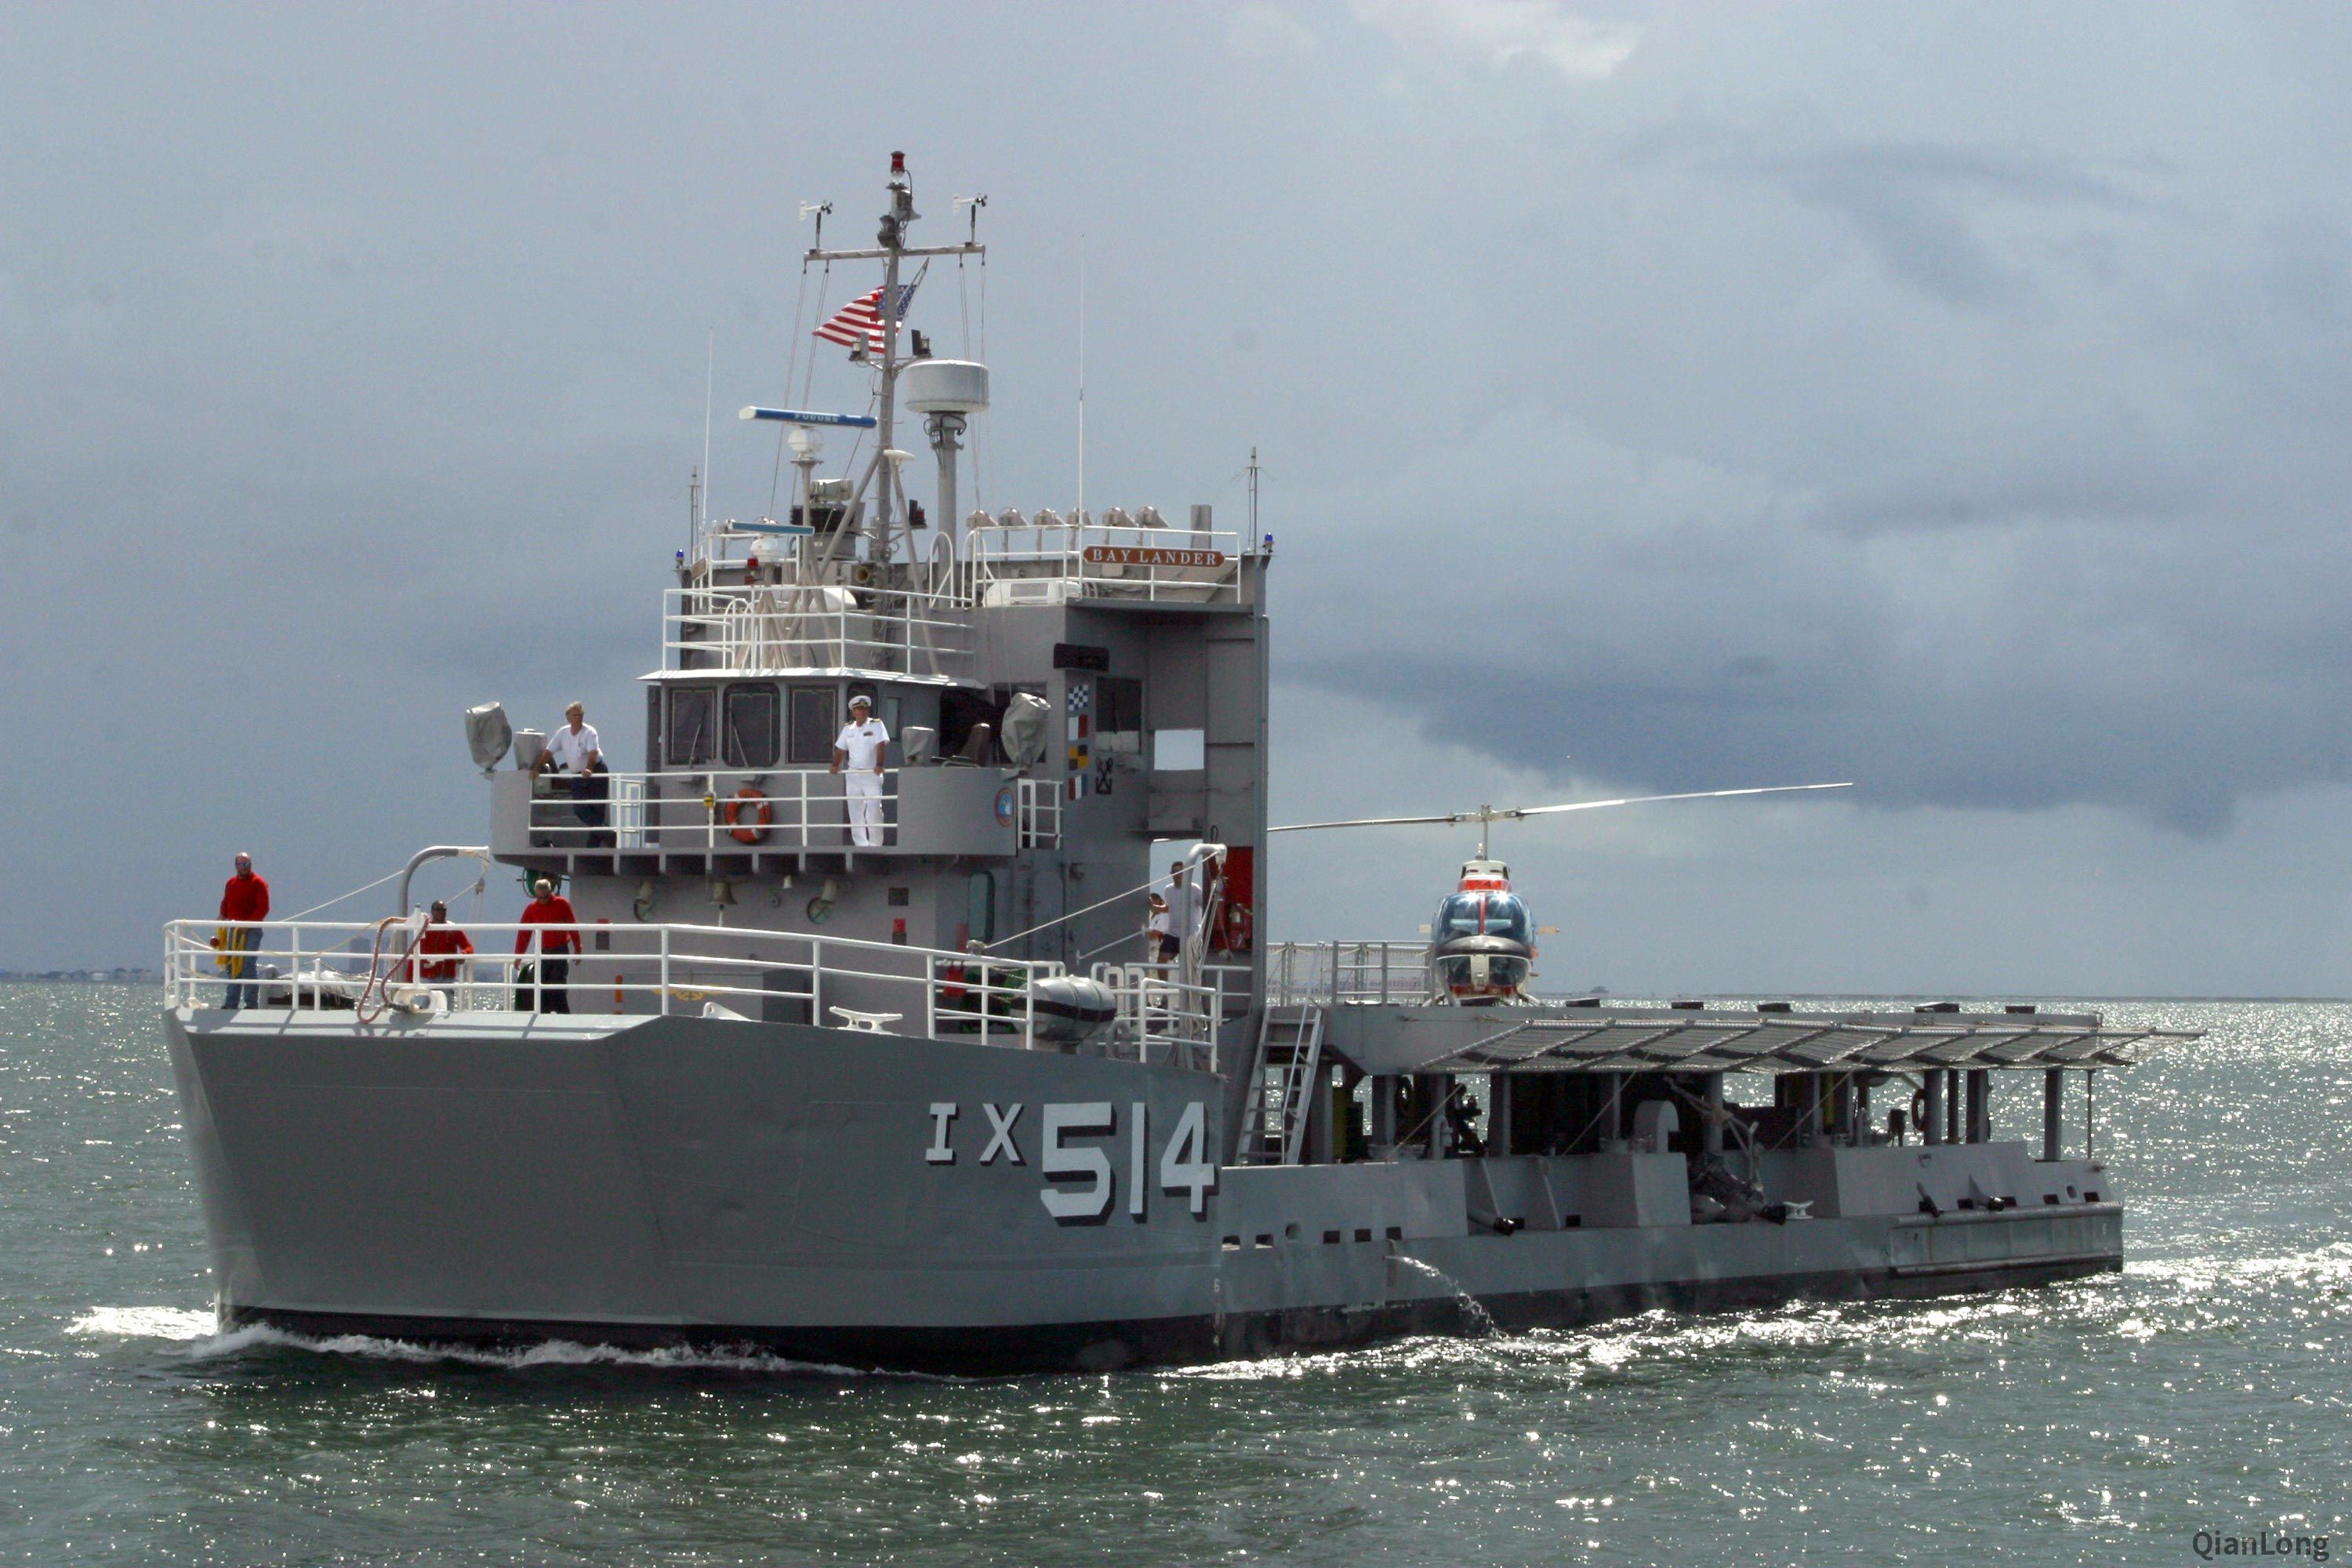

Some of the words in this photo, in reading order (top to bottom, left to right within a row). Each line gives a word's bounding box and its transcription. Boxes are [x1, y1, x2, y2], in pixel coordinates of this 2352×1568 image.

[1093, 549, 1131, 562] BAY
[1138, 550, 1217, 565] LANDER
[1040, 1101, 1216, 1219] 514
